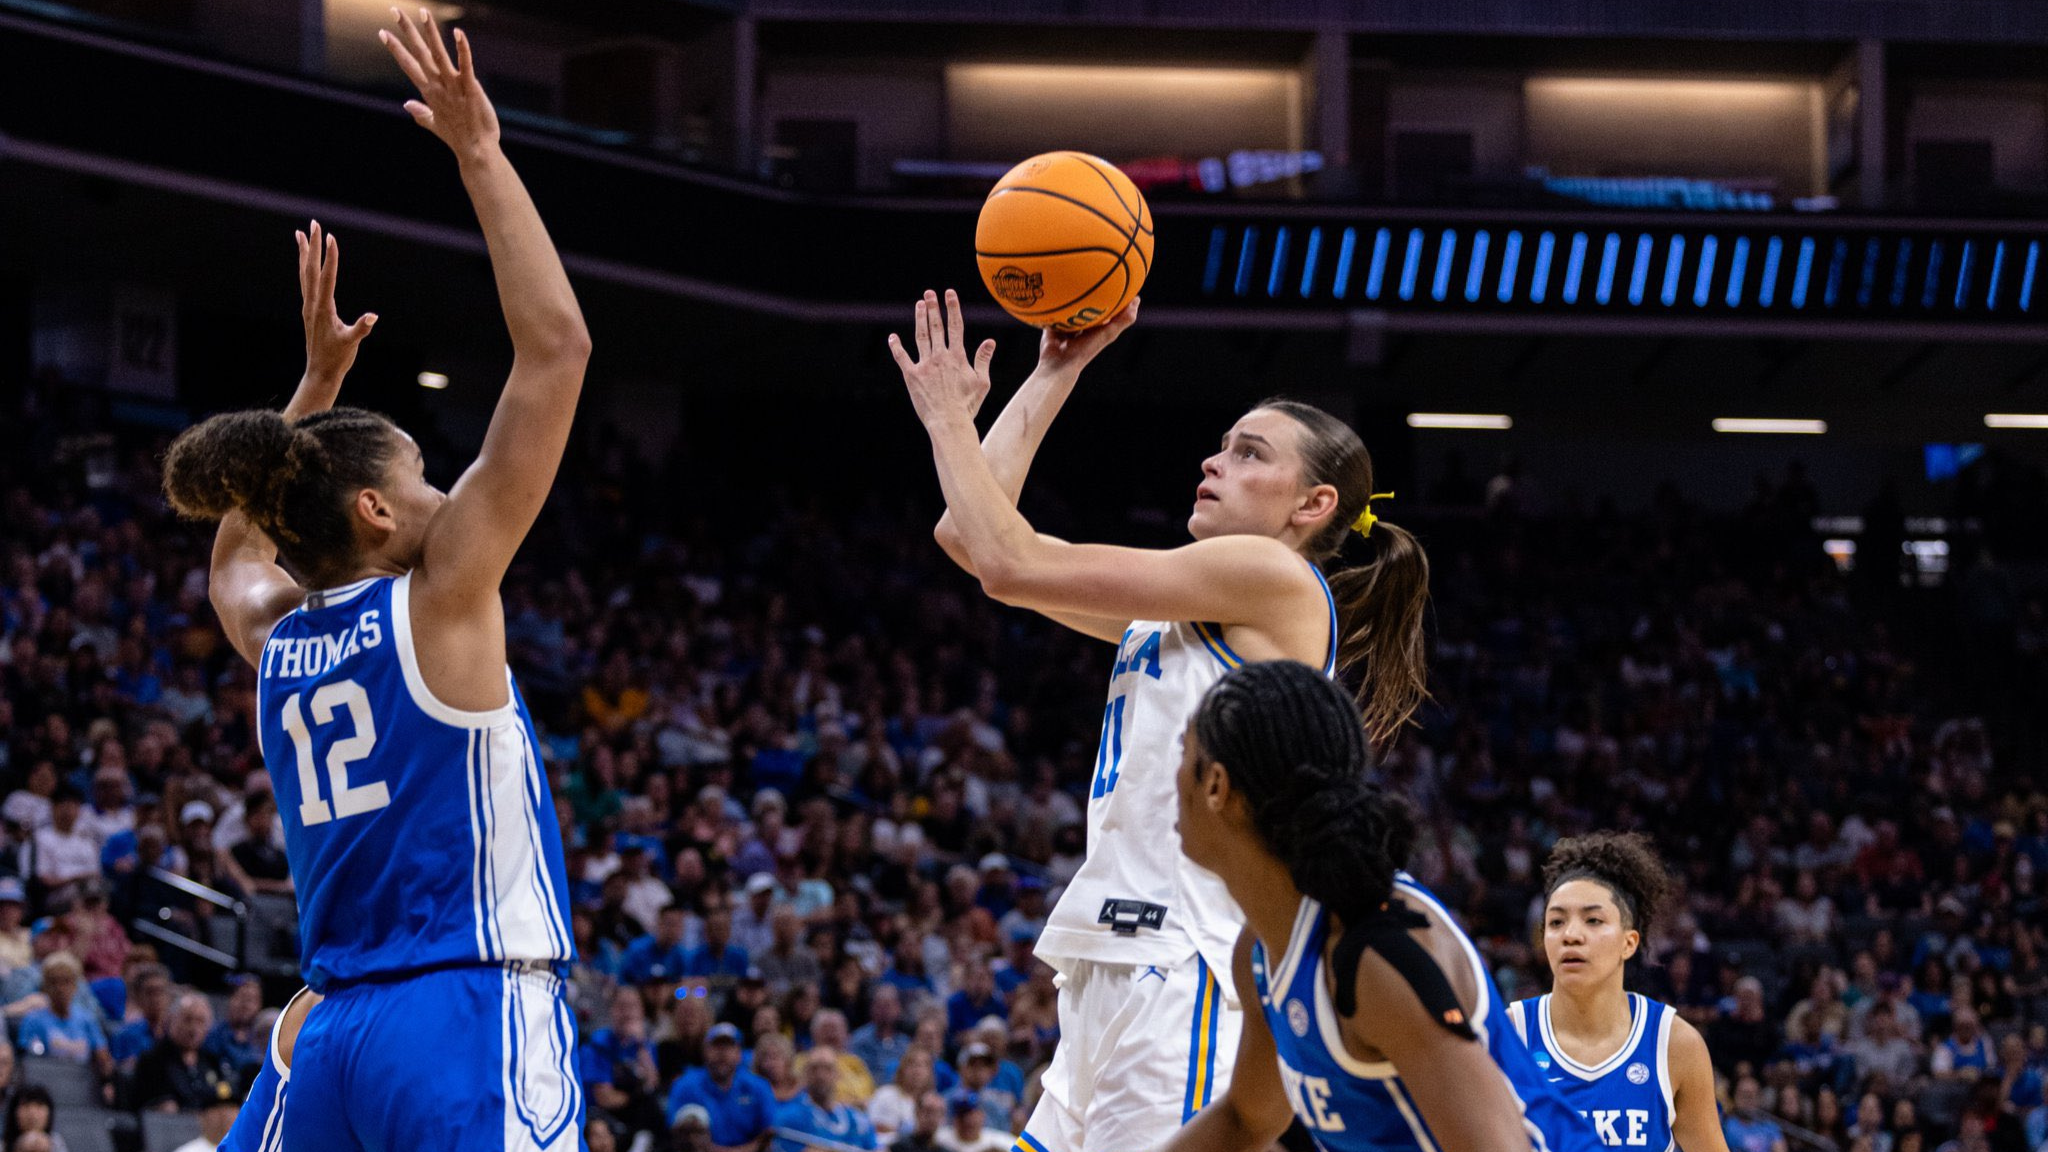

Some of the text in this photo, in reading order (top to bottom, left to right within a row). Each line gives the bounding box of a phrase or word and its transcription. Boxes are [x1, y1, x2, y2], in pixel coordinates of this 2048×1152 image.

[265, 609, 382, 679] THOMAS
[1112, 629, 1162, 683] LA
[281, 678, 391, 827] 12
[1092, 694, 1126, 799] 11
[1145, 910, 1158, 920] 44
[1577, 1109, 1649, 1146] KE
